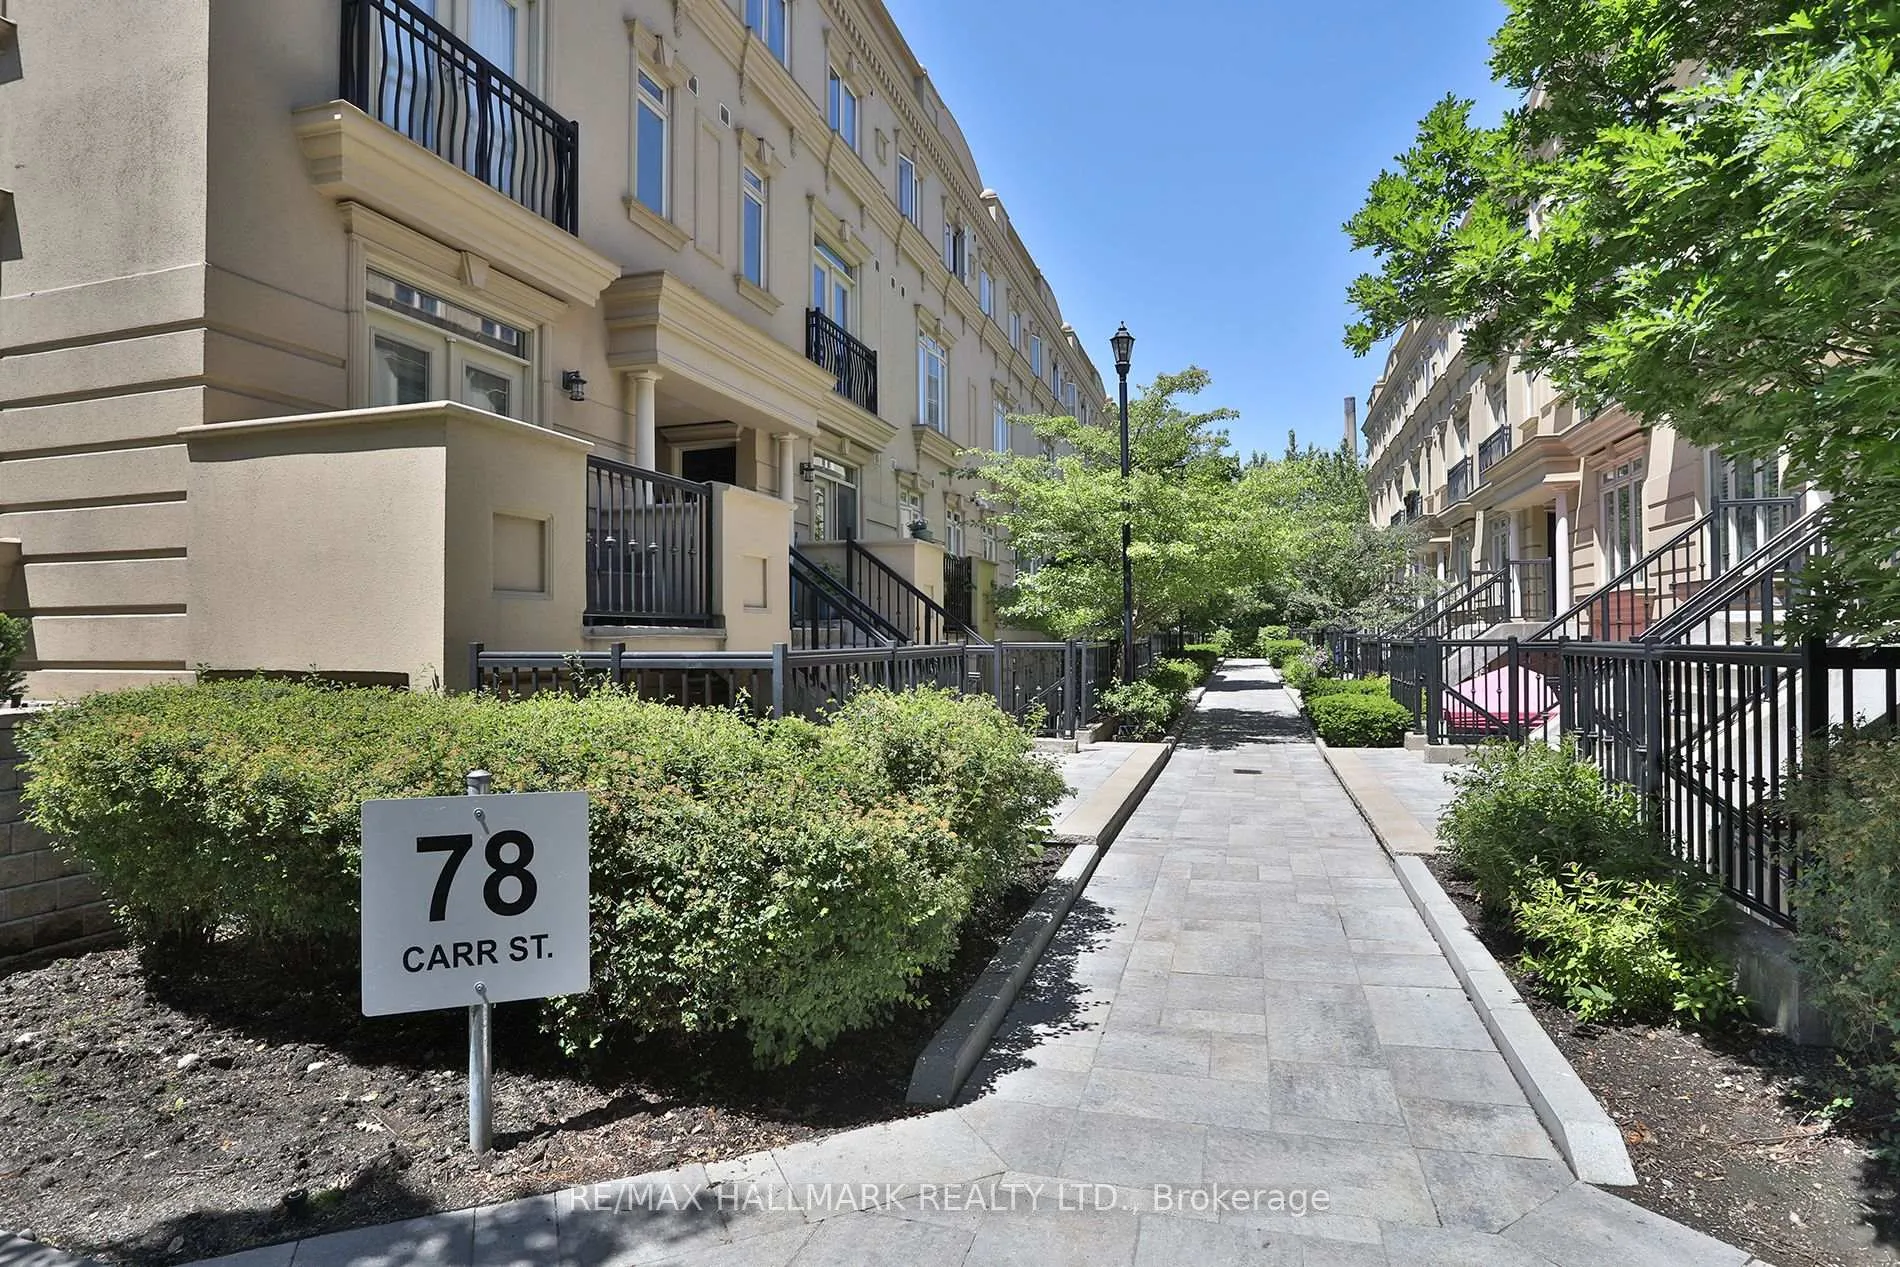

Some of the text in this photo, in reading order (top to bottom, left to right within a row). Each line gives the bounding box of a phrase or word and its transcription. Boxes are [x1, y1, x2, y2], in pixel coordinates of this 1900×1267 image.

[416, 829, 538, 923] 78
[402, 933, 553, 973] CARR ST.
